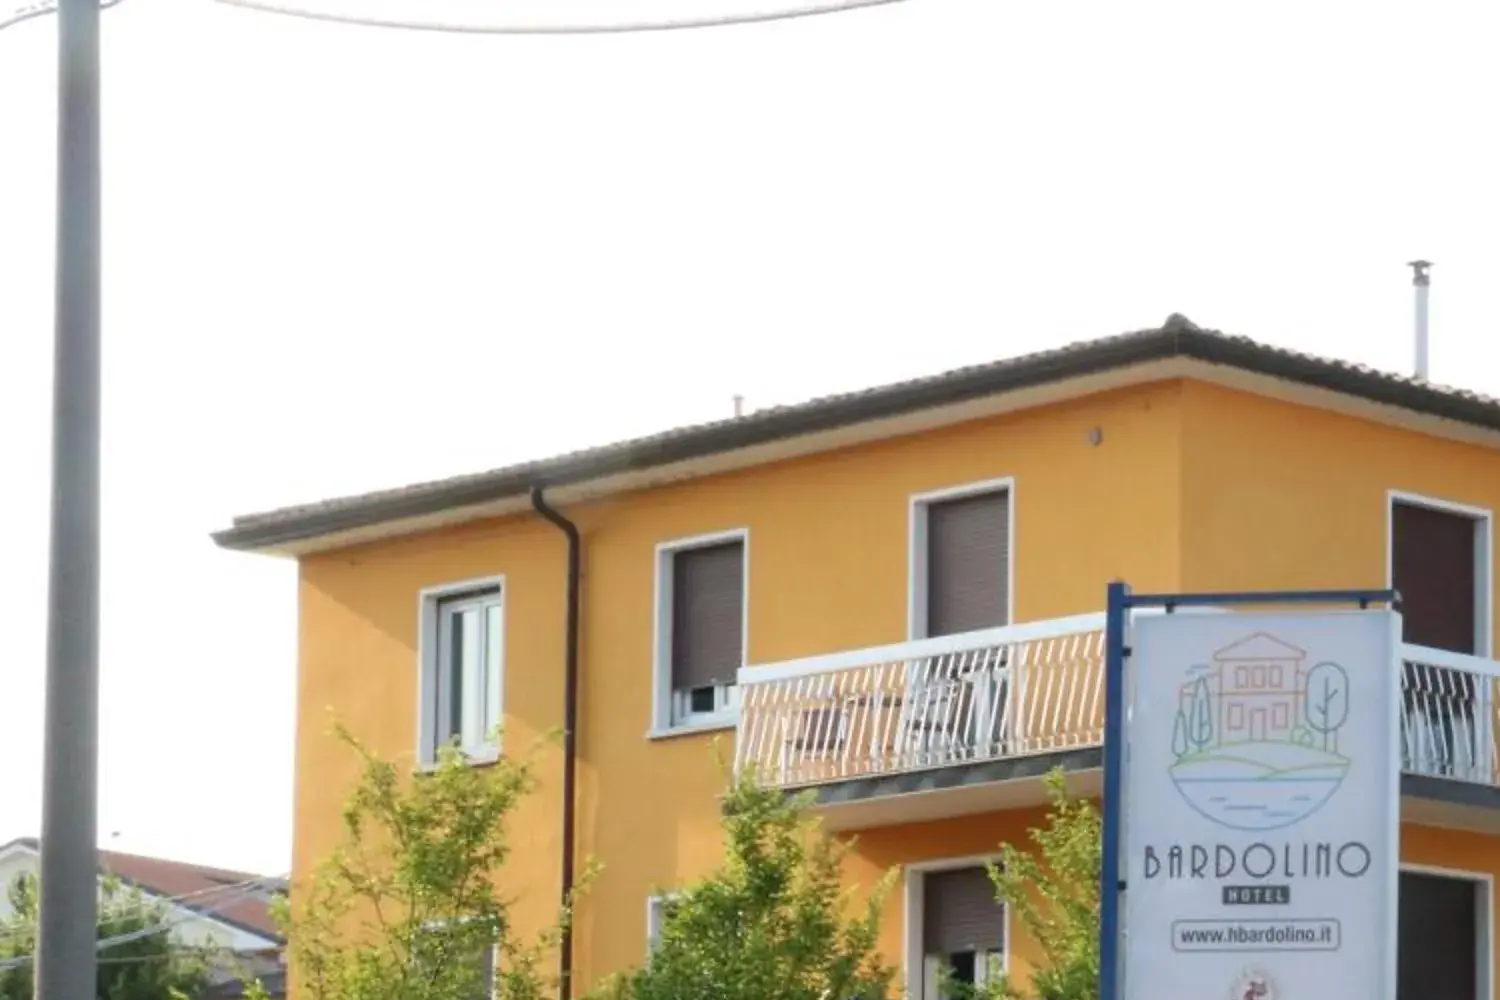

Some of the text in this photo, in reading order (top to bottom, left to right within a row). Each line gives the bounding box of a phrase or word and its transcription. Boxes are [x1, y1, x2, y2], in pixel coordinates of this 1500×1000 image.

[1144, 841, 1372, 879] BARDOLINO
[1228, 888, 1287, 903] HOTEL
[1181, 925, 1332, 944] www.hbardolino.it
